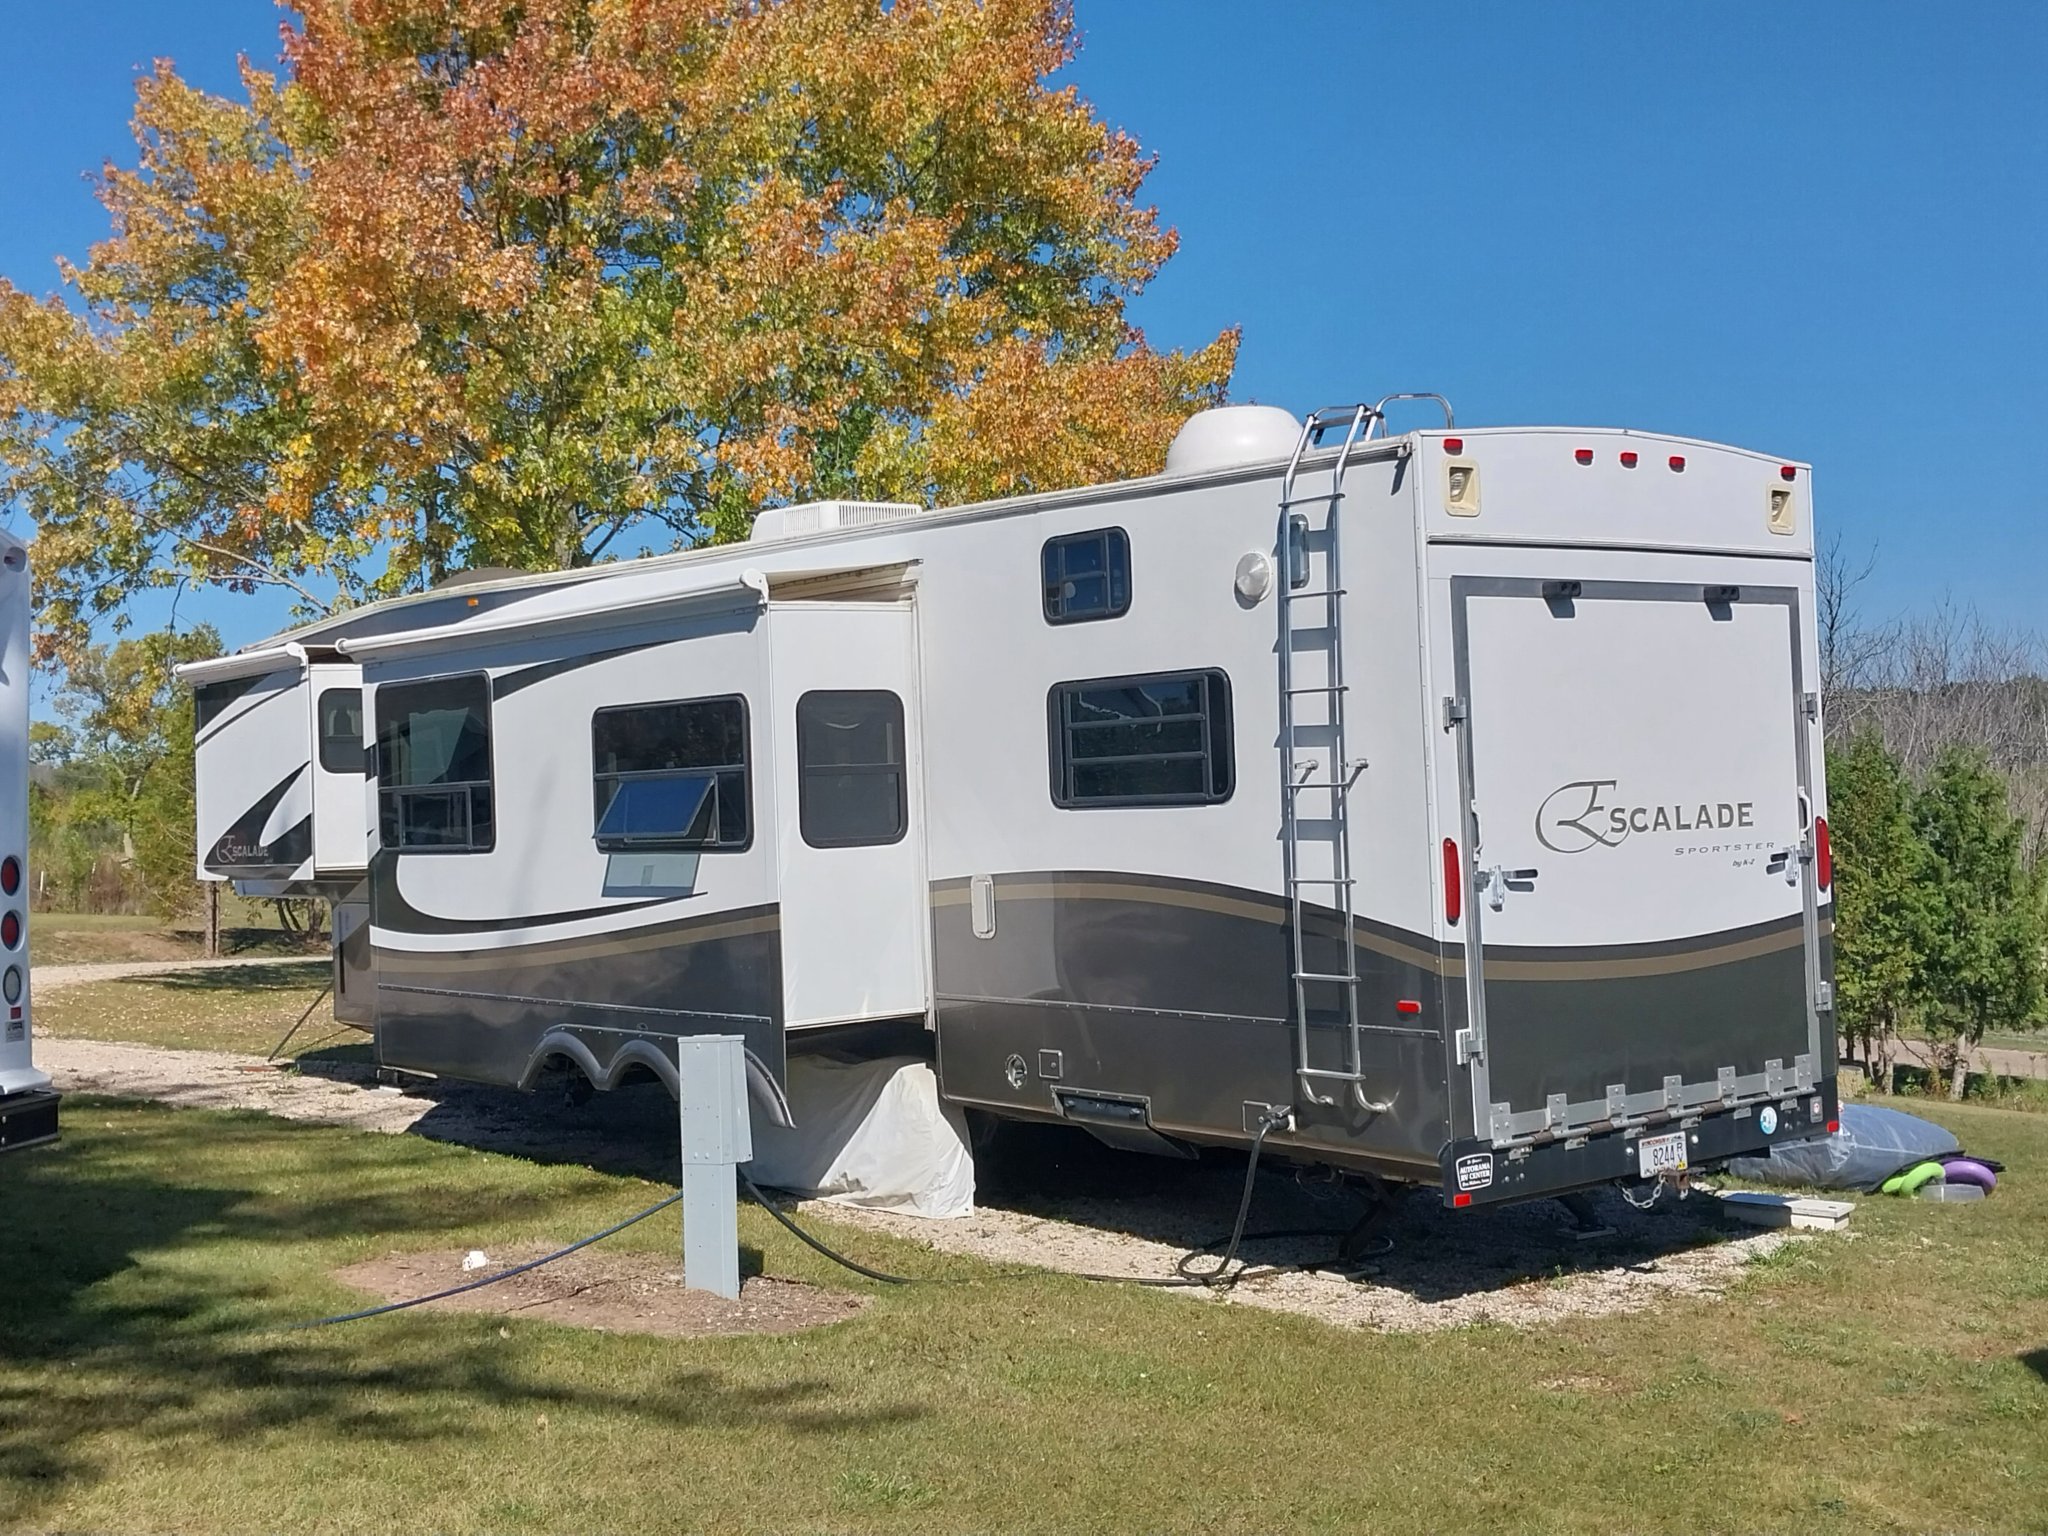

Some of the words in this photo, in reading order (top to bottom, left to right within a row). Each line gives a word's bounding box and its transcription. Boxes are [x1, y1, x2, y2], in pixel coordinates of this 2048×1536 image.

[1535, 780, 1754, 854] ESCALADE
[216, 835, 269, 863] ESCALADE
[1674, 842, 1775, 856] SPORTSTER
[1653, 1144, 1675, 1166] 8244
[1459, 1162, 1491, 1174] AUTORAMA
[1460, 1173, 1469, 1182] RV
[1469, 1169, 1490, 1180] CENTER
